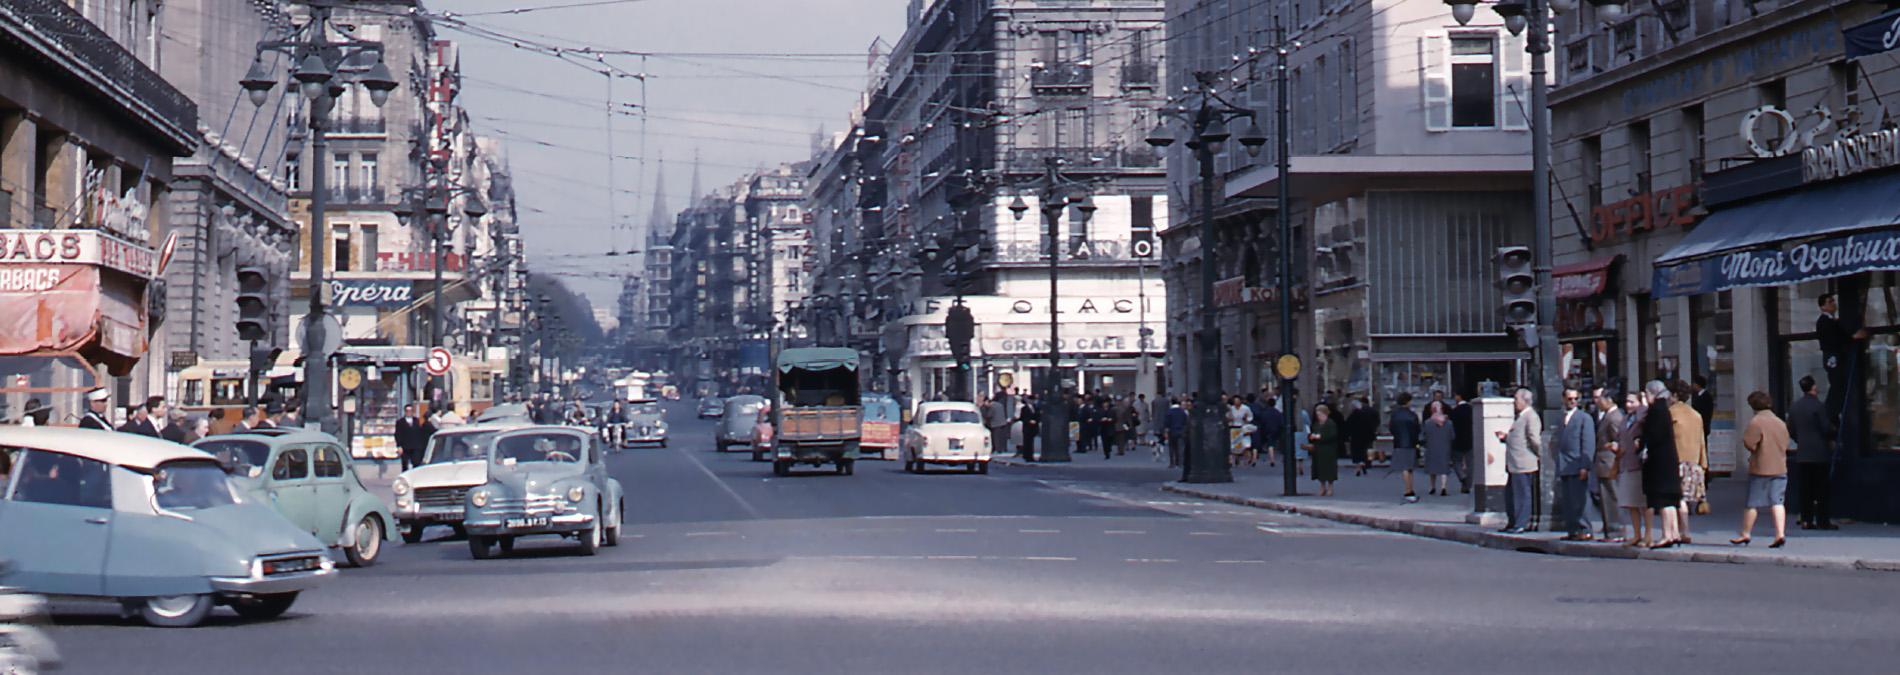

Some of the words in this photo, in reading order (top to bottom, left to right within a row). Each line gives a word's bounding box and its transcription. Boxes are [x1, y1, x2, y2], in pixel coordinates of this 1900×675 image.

[1591, 184, 1697, 242] OFFICE
[1720, 250, 1789, 280] Mont
[1790, 235, 1900, 273] Ventoux
[330, 280, 411, 307] Opéra
[1001, 339, 1067, 351] GRAND
